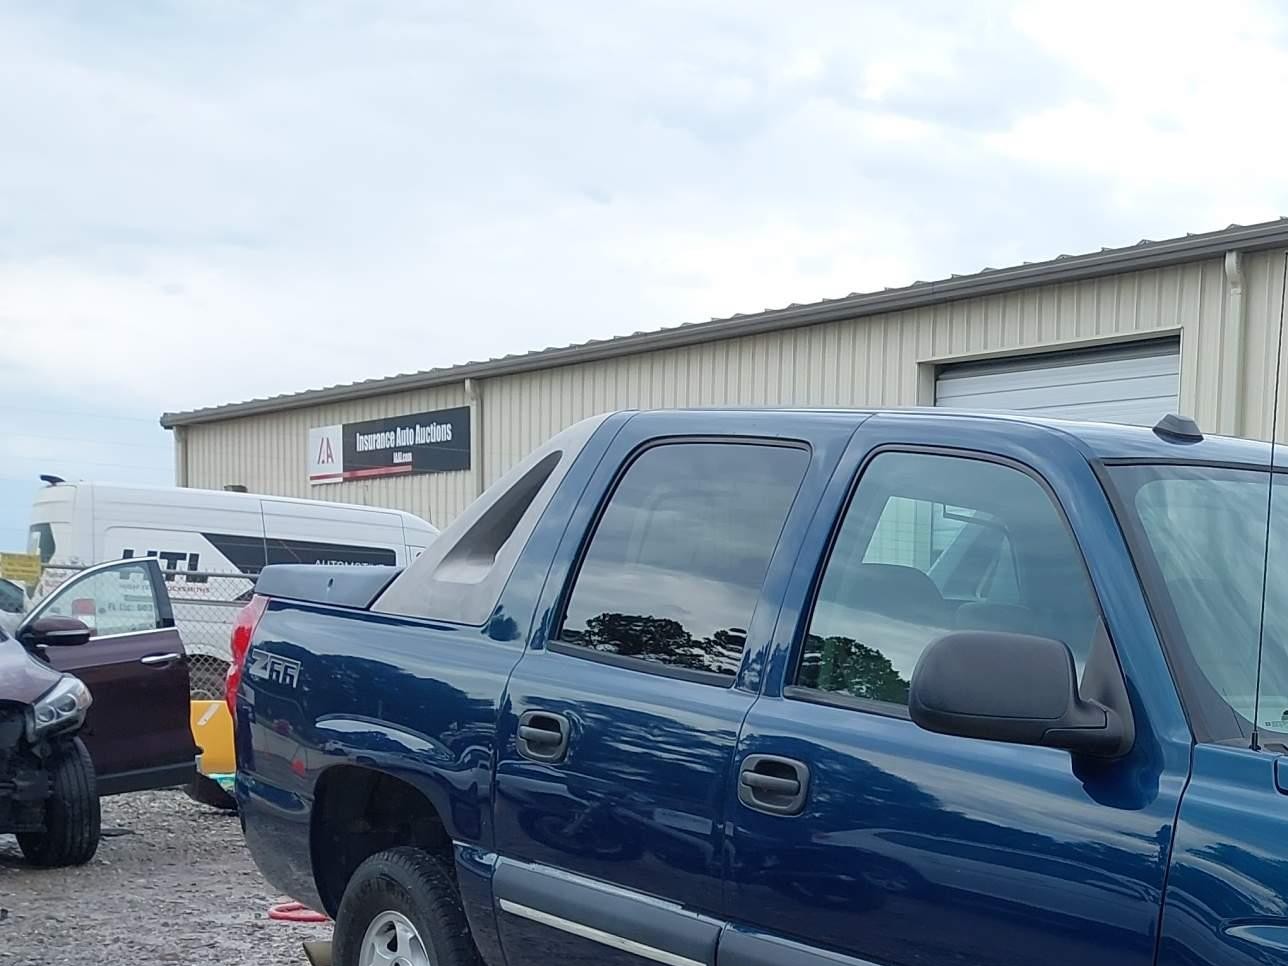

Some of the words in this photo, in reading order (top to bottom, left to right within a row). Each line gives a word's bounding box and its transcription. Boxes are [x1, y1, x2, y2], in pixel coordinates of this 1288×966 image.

[356, 432, 395, 452] Insurance
[396, 427, 414, 446] Auto
[415, 422, 453, 444] Auctions
